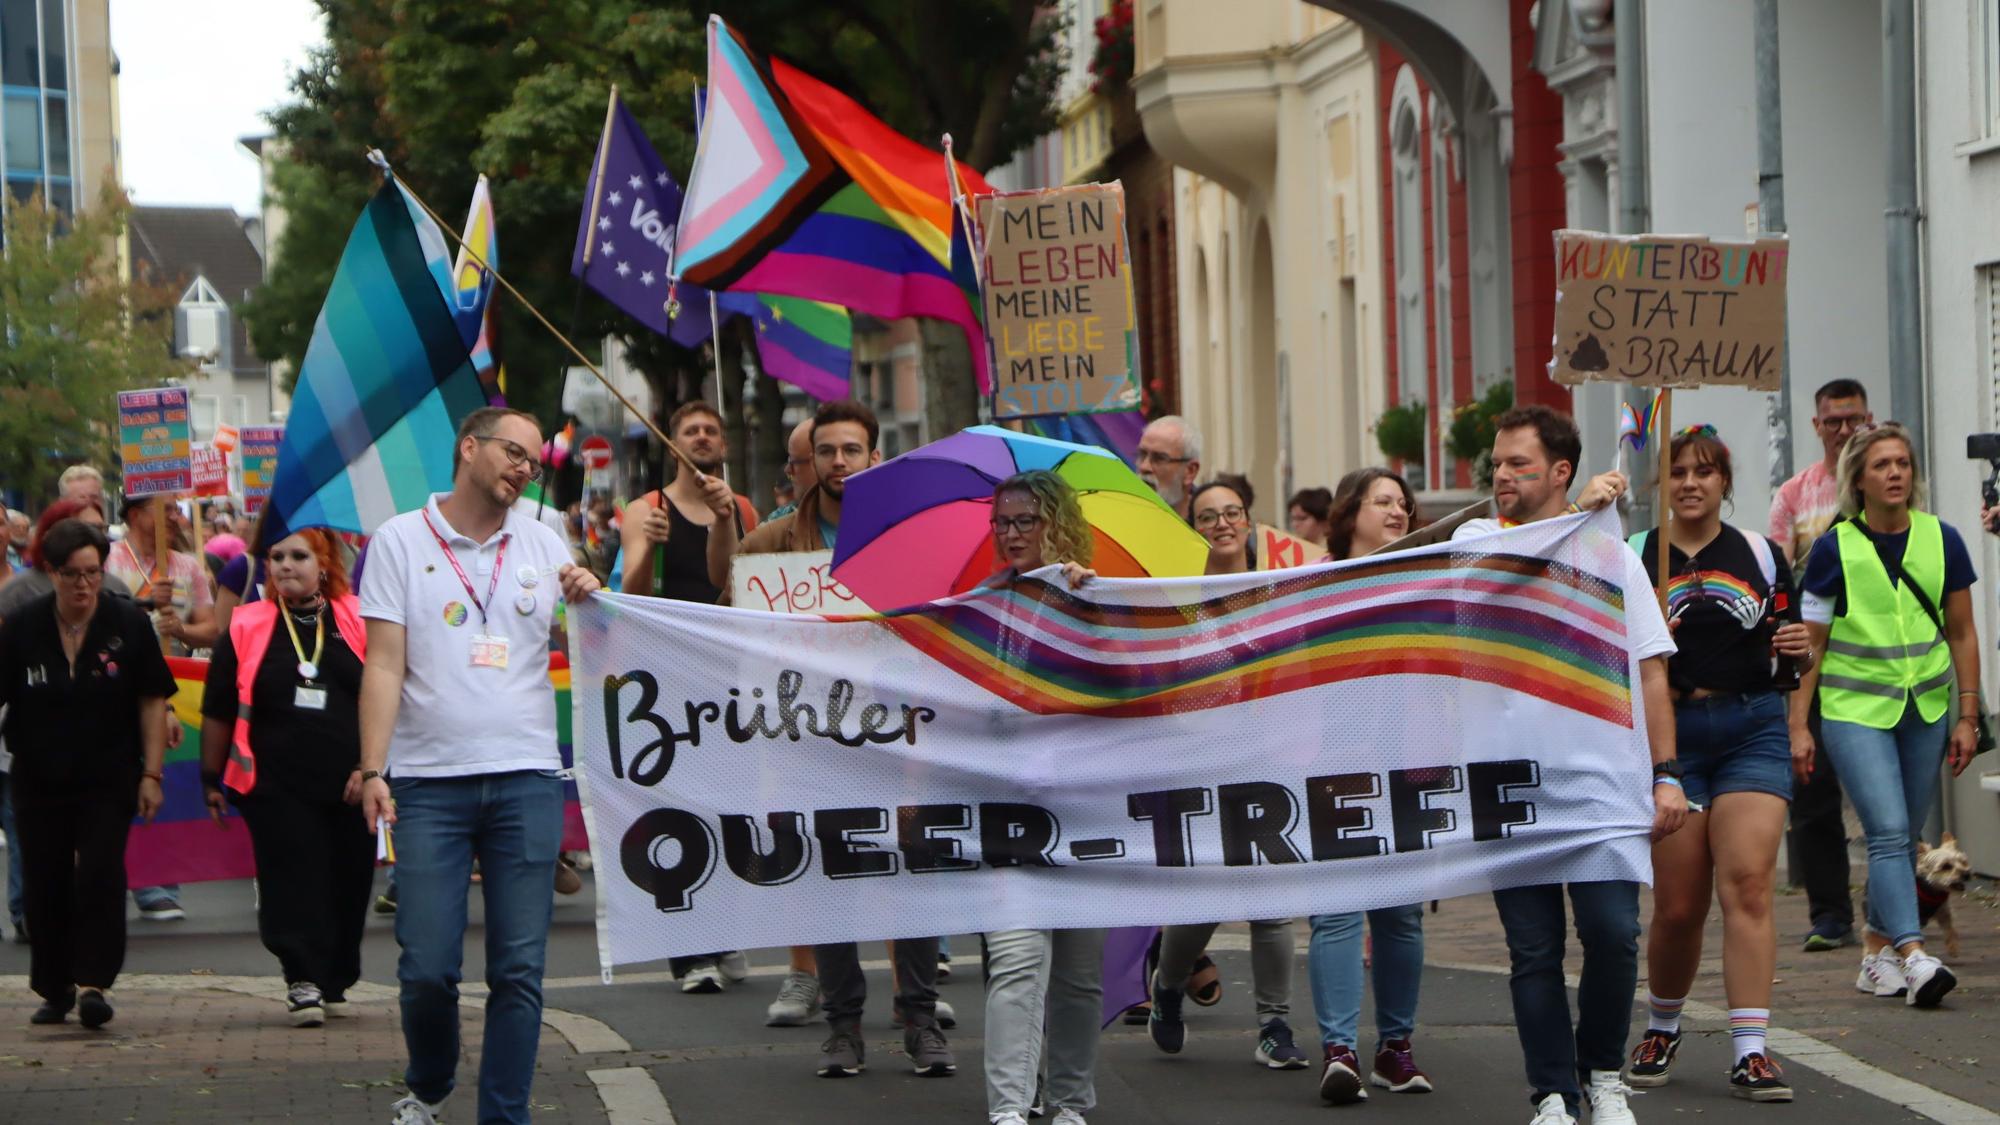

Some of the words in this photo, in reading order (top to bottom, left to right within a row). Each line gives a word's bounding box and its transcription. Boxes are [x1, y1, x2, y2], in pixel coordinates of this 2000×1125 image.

[1003, 200, 1104, 243] MEIN
[986, 242, 1117, 287] LEBEN
[1561, 240, 1787, 287] KUNTERBUNT
[995, 284, 1092, 319] MEINE
[1588, 284, 1739, 330] STATT
[1003, 316, 1105, 357] LIEBE
[1011, 353, 1095, 383] MEIN
[120, 392, 158, 408] LEBE
[1002, 374, 1127, 416] STOLZ
[603, 669, 936, 787] Brühler
[620, 759, 1541, 913] QUEER-TREFF
